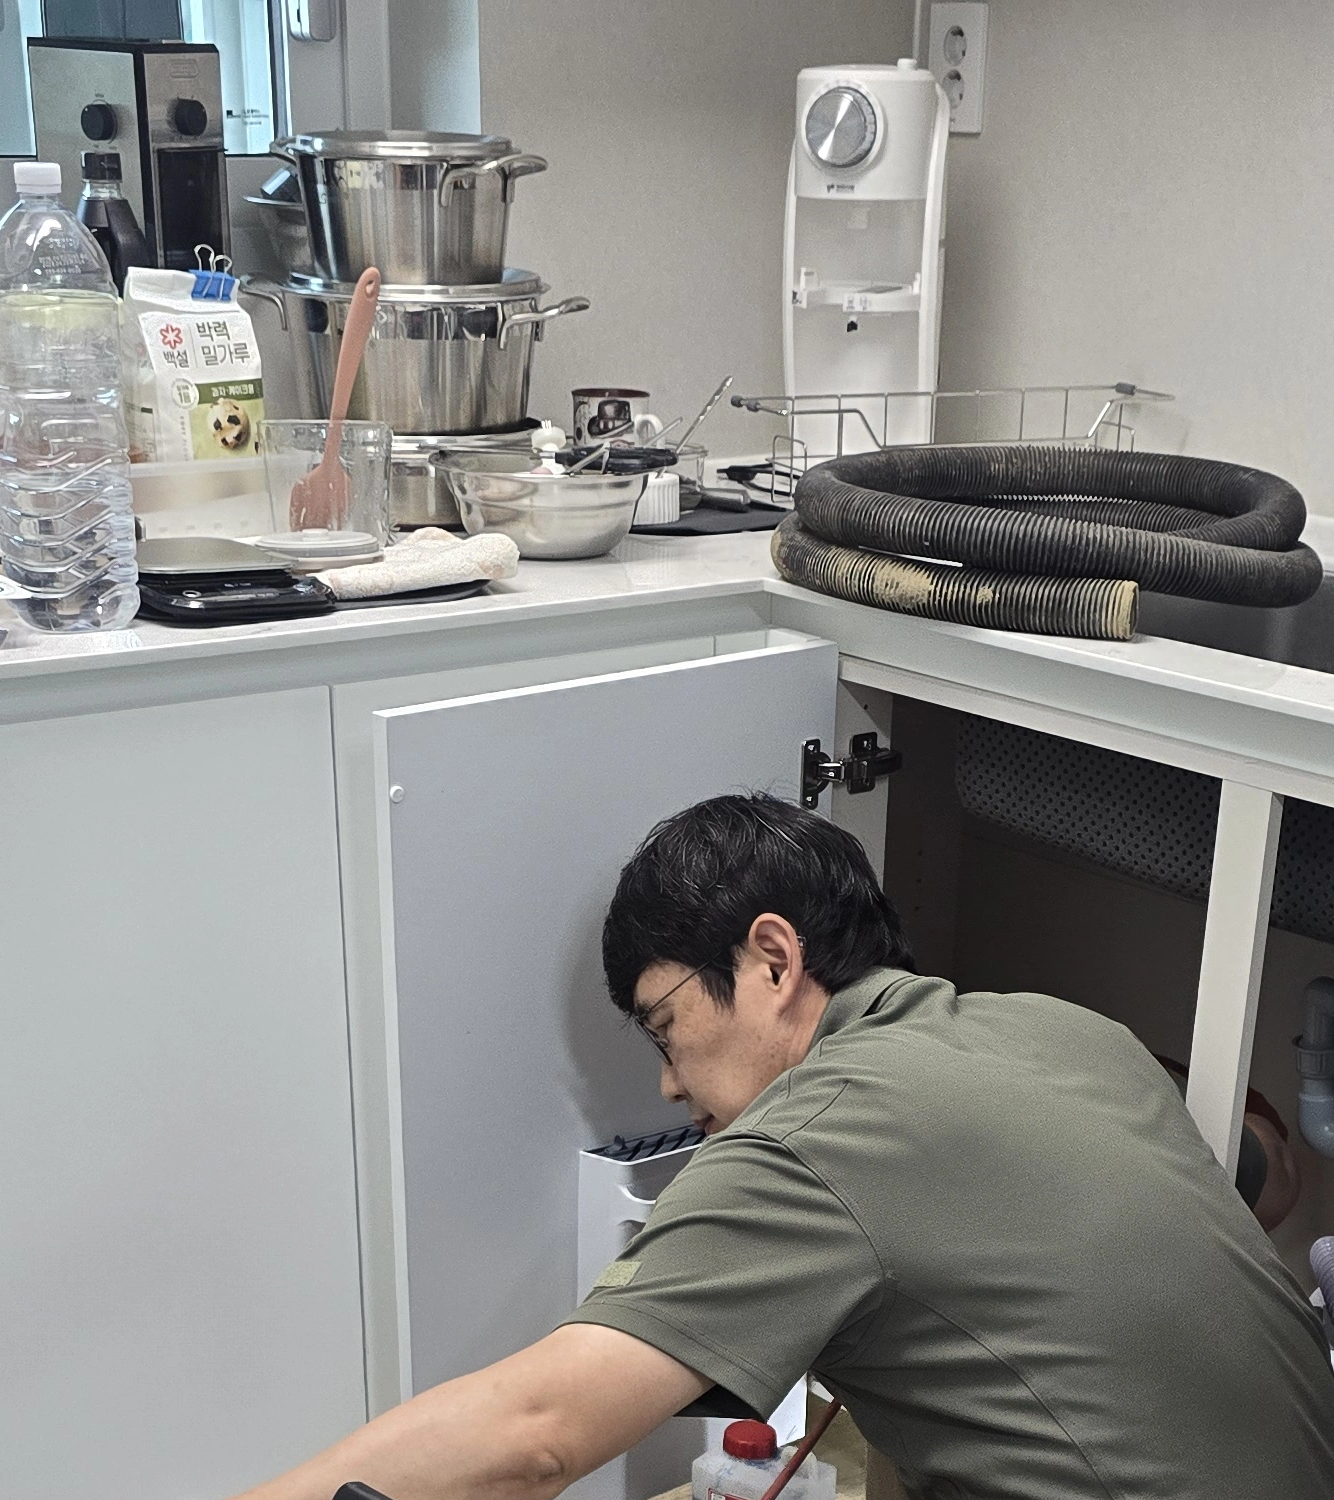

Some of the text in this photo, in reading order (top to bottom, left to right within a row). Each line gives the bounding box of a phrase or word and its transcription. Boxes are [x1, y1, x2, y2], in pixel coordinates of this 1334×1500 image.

[196, 321, 231, 341] 박력
[163, 350, 189, 368] 백설
[202, 343, 250, 366] 밀가루
